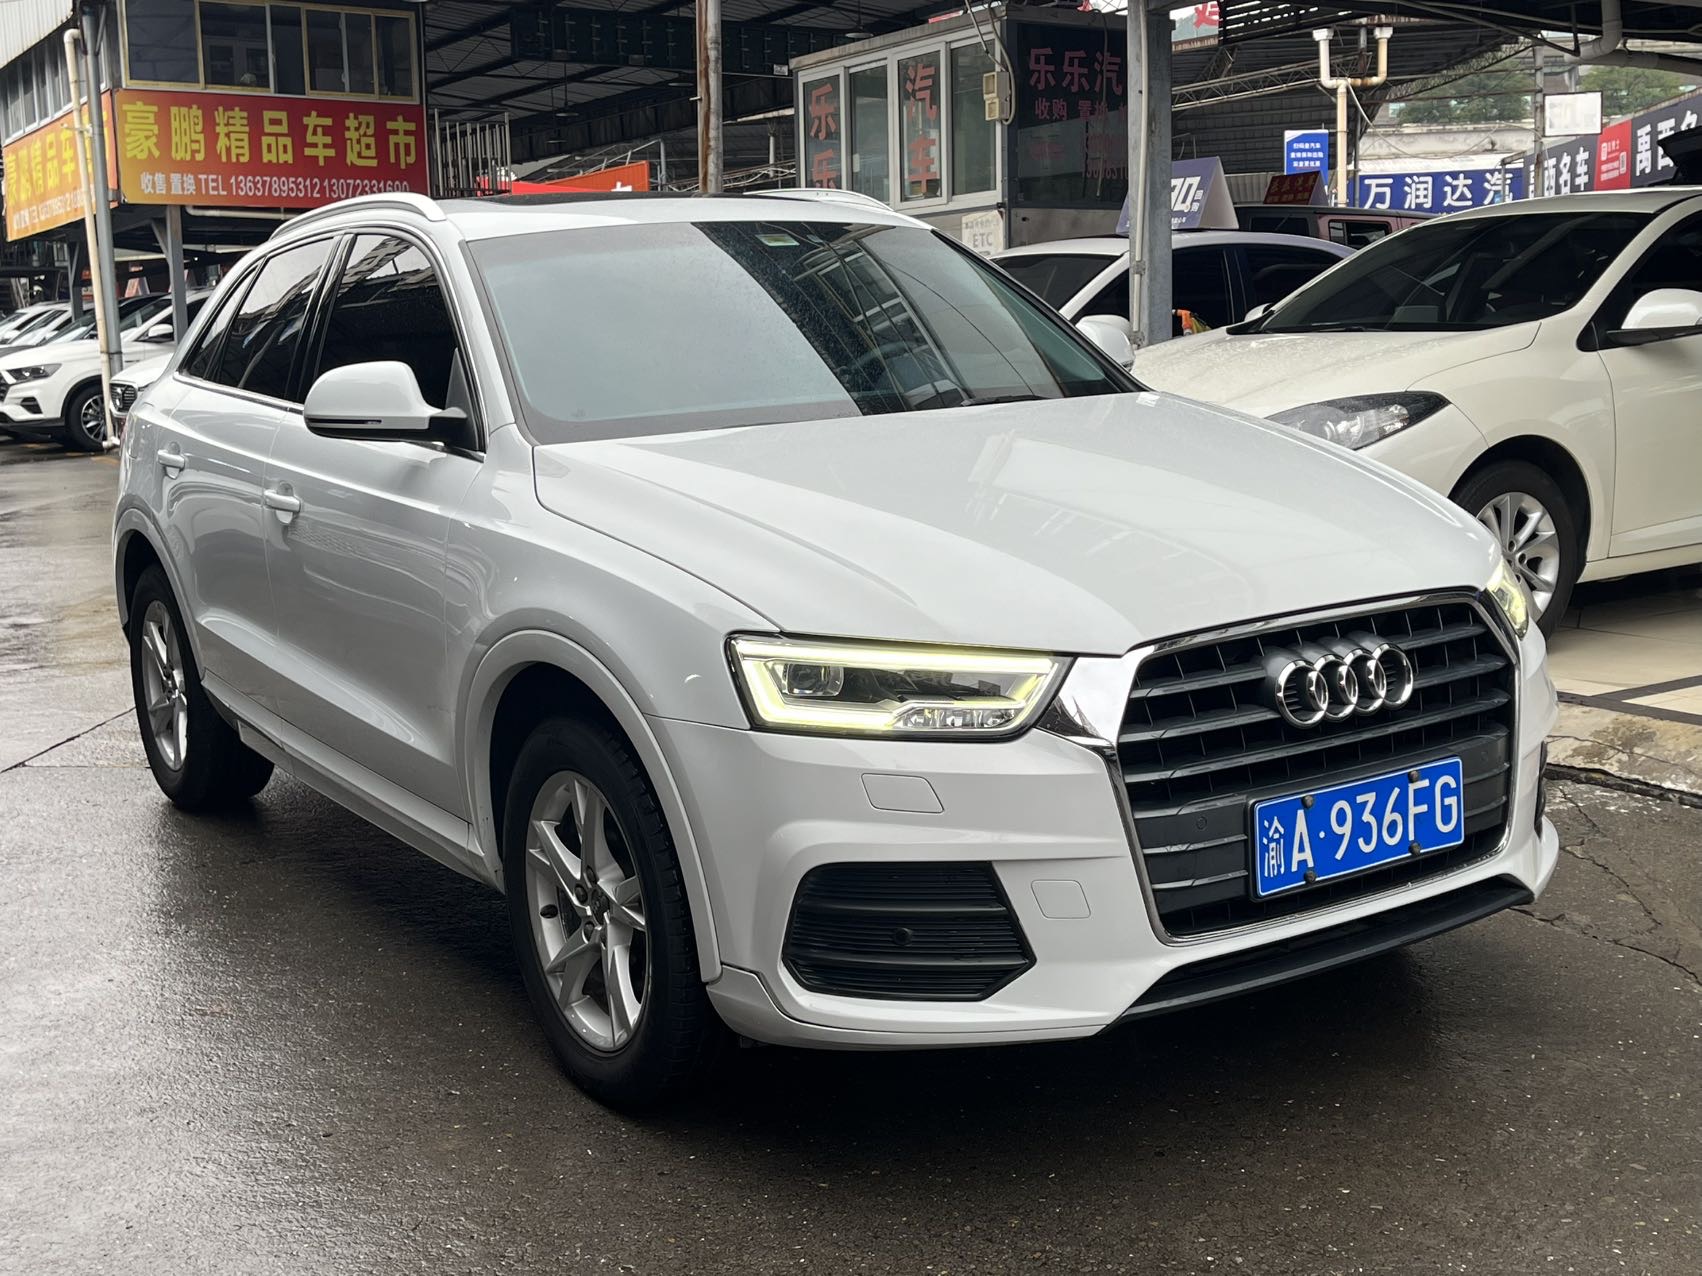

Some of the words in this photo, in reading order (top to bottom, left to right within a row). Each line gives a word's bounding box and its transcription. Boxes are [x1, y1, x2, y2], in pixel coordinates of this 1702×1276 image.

[122, 101, 417, 170] 豪鹏精品车超市
[905, 63, 938, 197] 汽车
[140, 171, 167, 195] 收售
[170, 172, 196, 195] 置换
[198, 174, 228, 196] TEL
[230, 175, 321, 198] 13637895312
[1363, 171, 1514, 210] 万润达汽
[1528, 146, 1590, 200] 西名车
[972, 232, 993, 249] ETC
